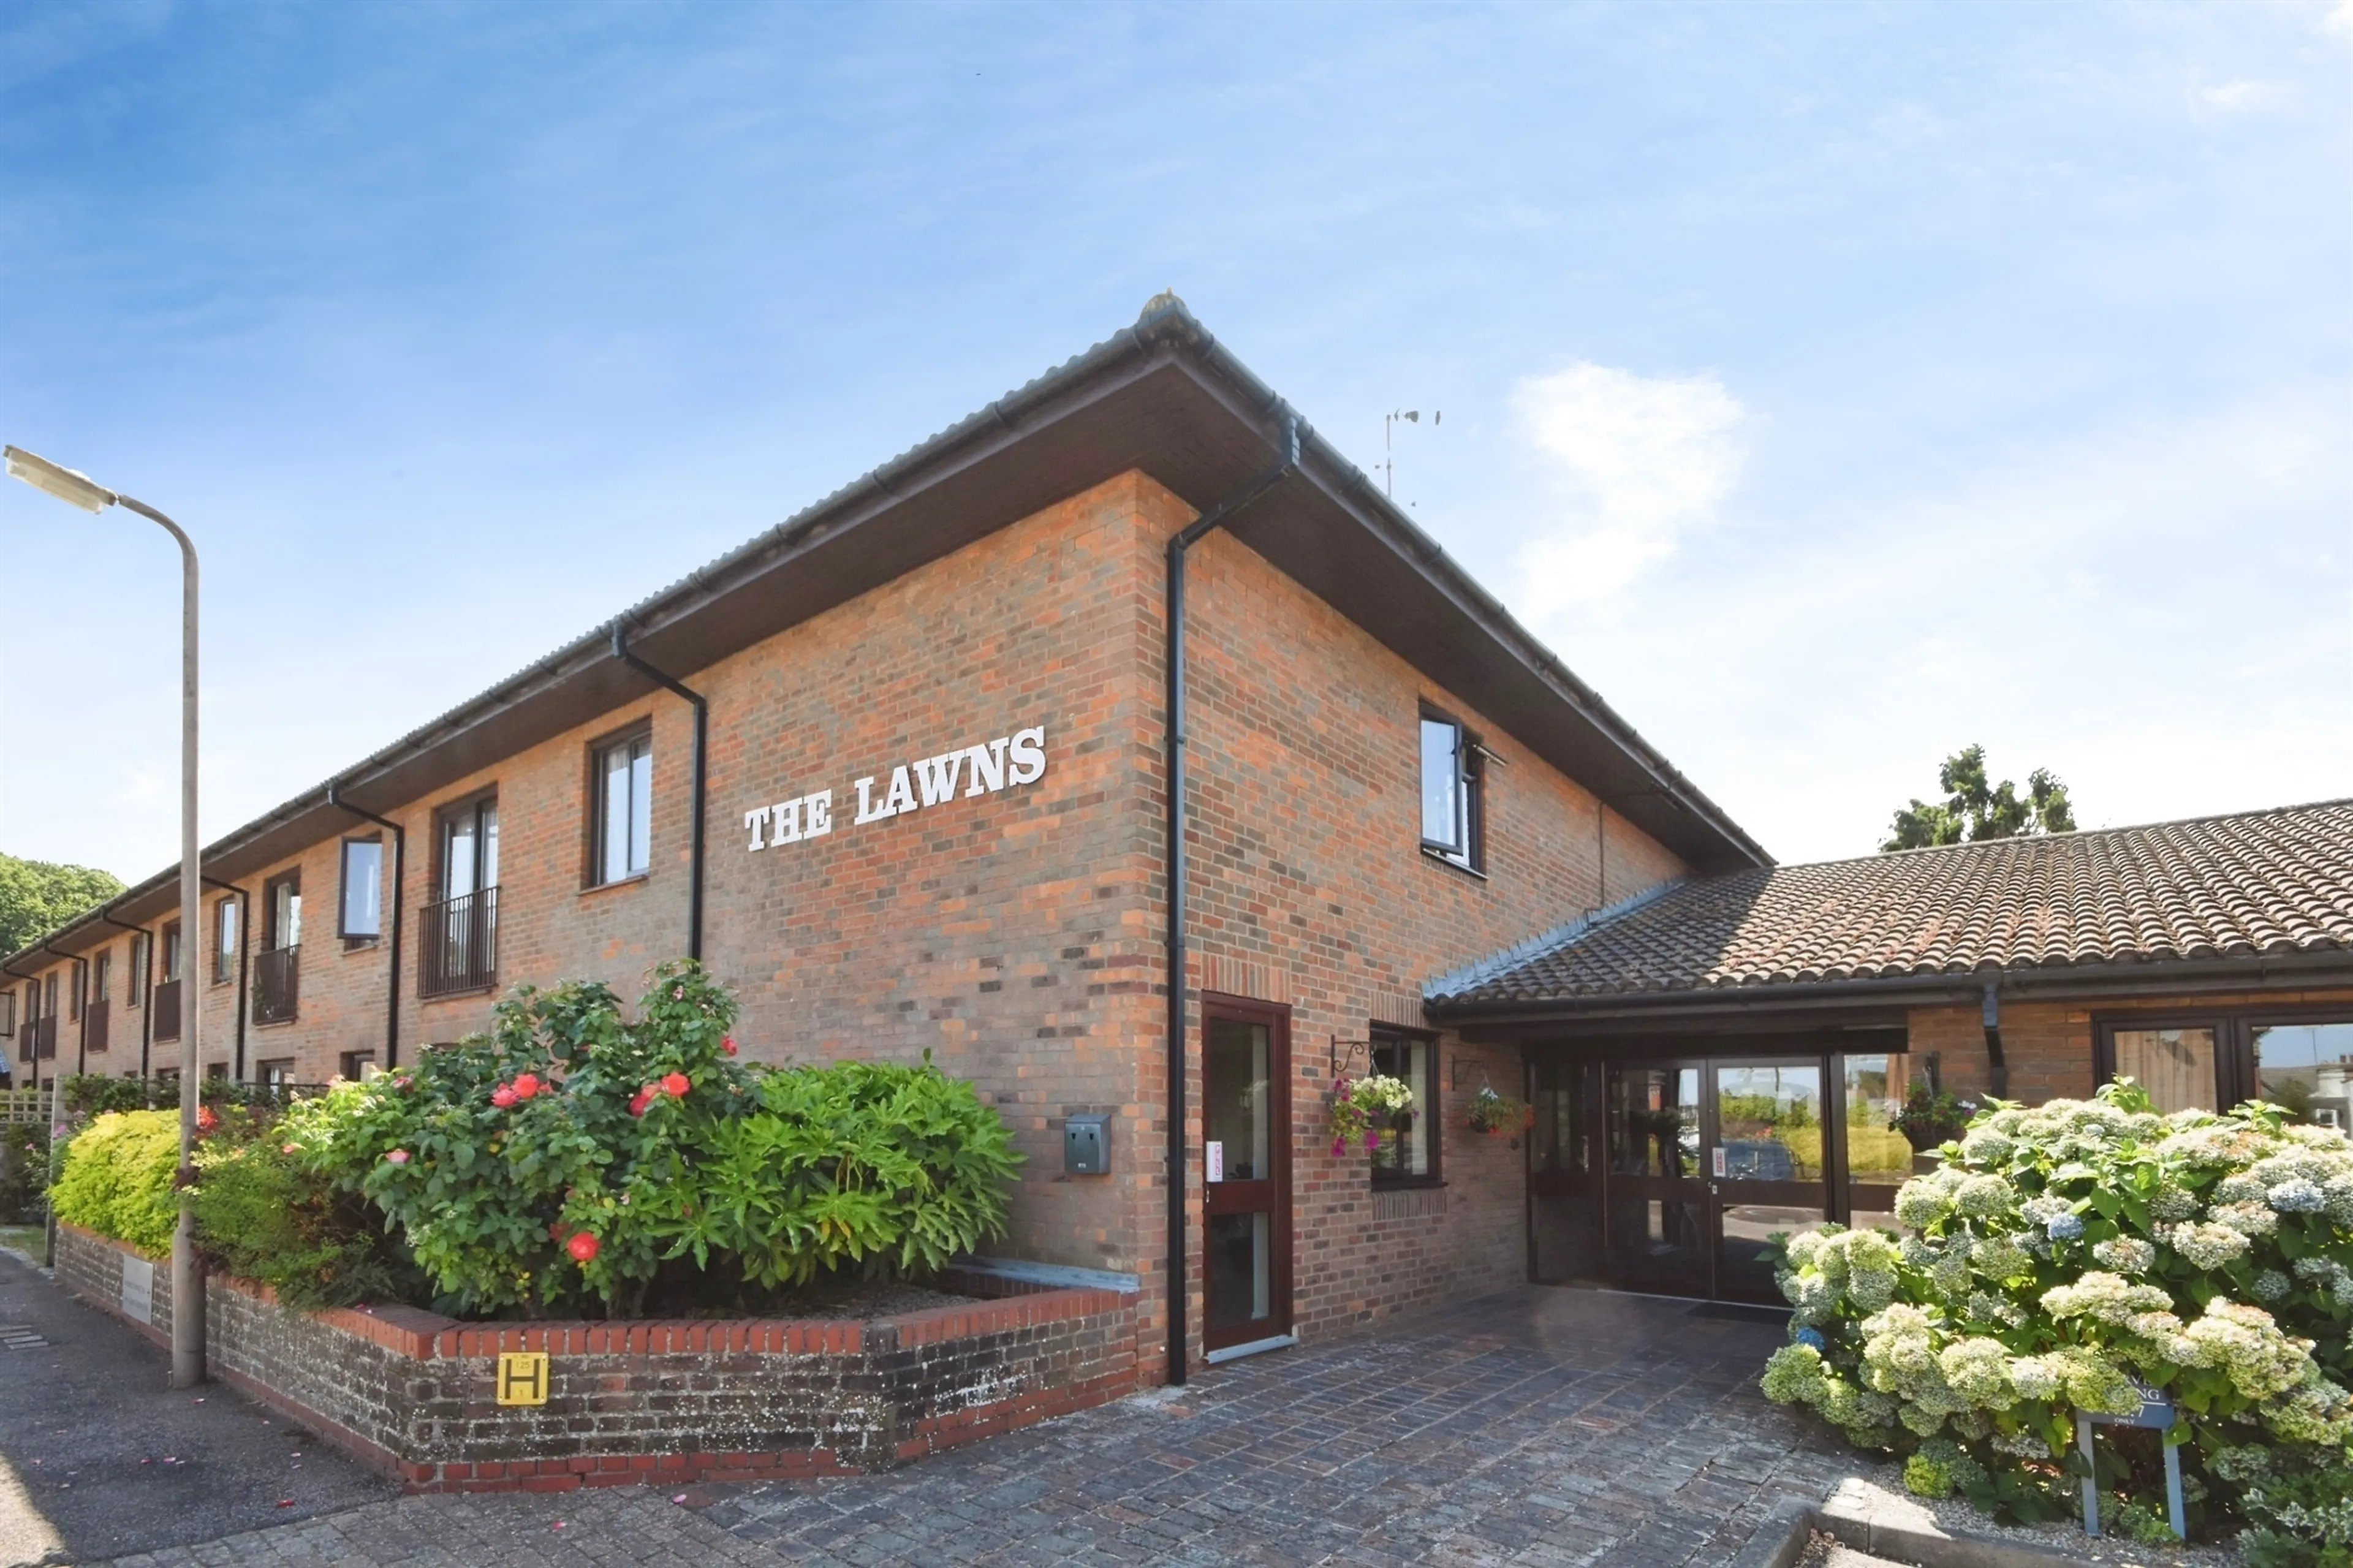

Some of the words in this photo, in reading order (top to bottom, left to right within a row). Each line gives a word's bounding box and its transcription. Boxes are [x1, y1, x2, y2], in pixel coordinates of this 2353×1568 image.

[745, 789, 832, 852] THE
[854, 725, 1047, 826] LAWNS
[505, 1358, 540, 1399] H
